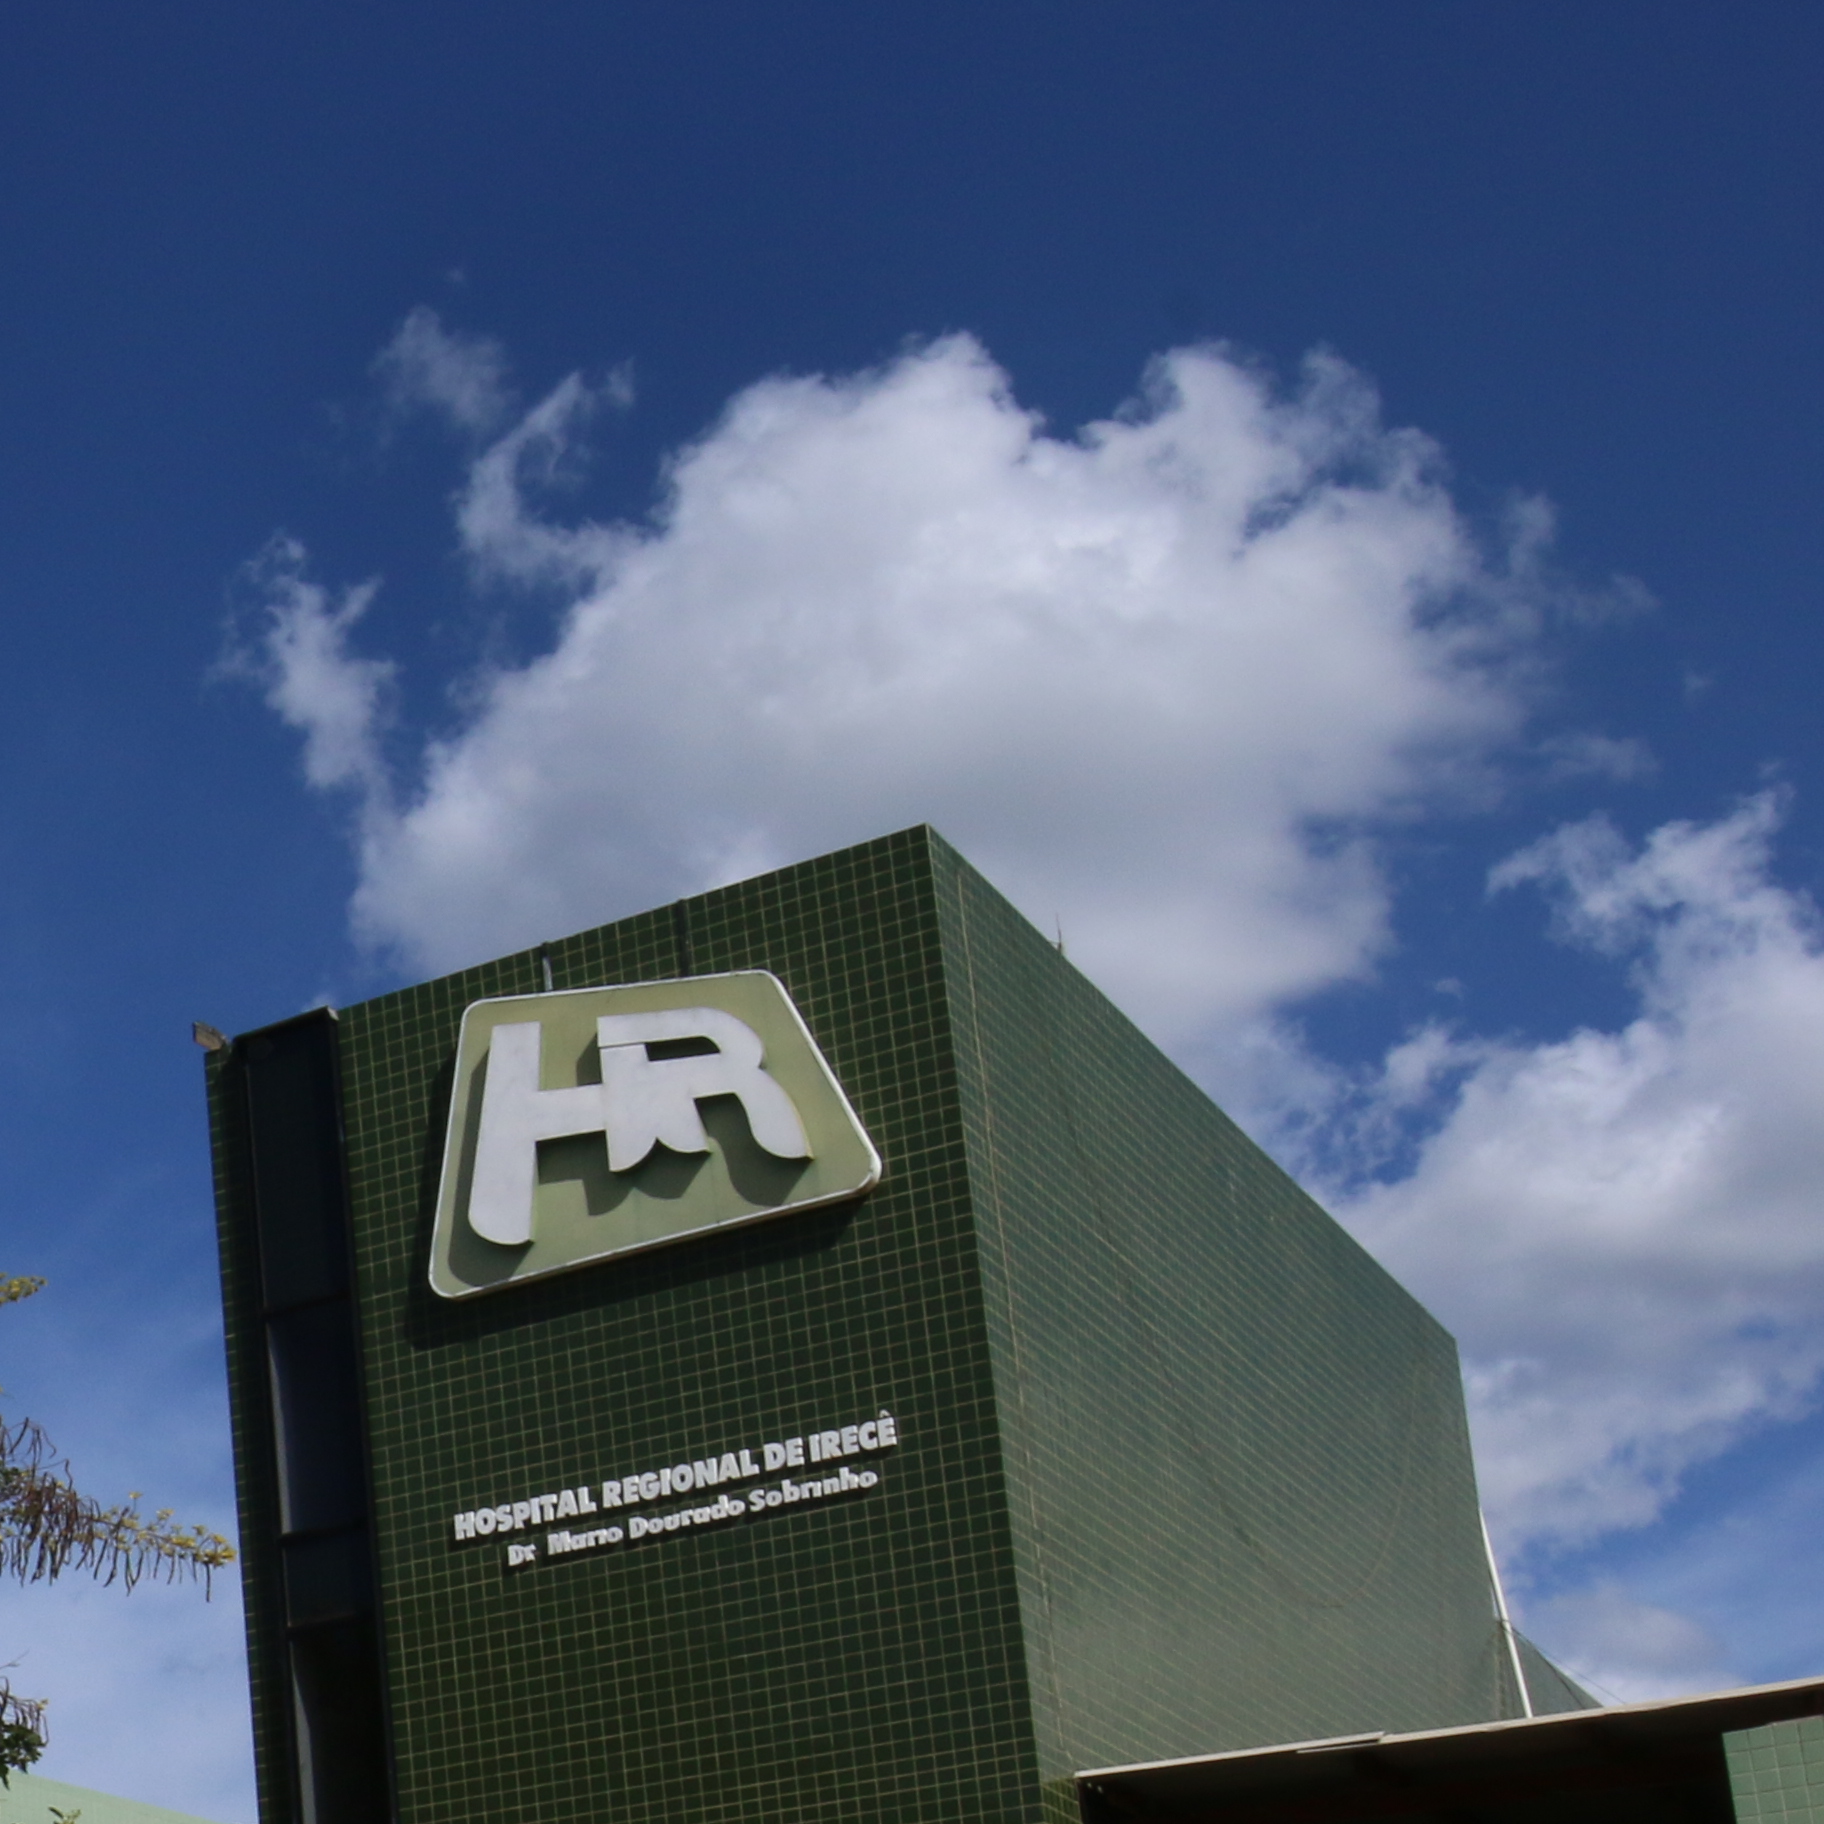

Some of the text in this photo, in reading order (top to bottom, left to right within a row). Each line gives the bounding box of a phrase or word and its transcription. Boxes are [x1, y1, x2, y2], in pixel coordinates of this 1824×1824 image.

[453, 1408, 898, 1541] HOSPITAL REGIONAL DE IRECÊ
[547, 1525, 624, 1556] Mario
[628, 1493, 746, 1540] Dourado
[748, 1466, 879, 1512] Sobrinho
